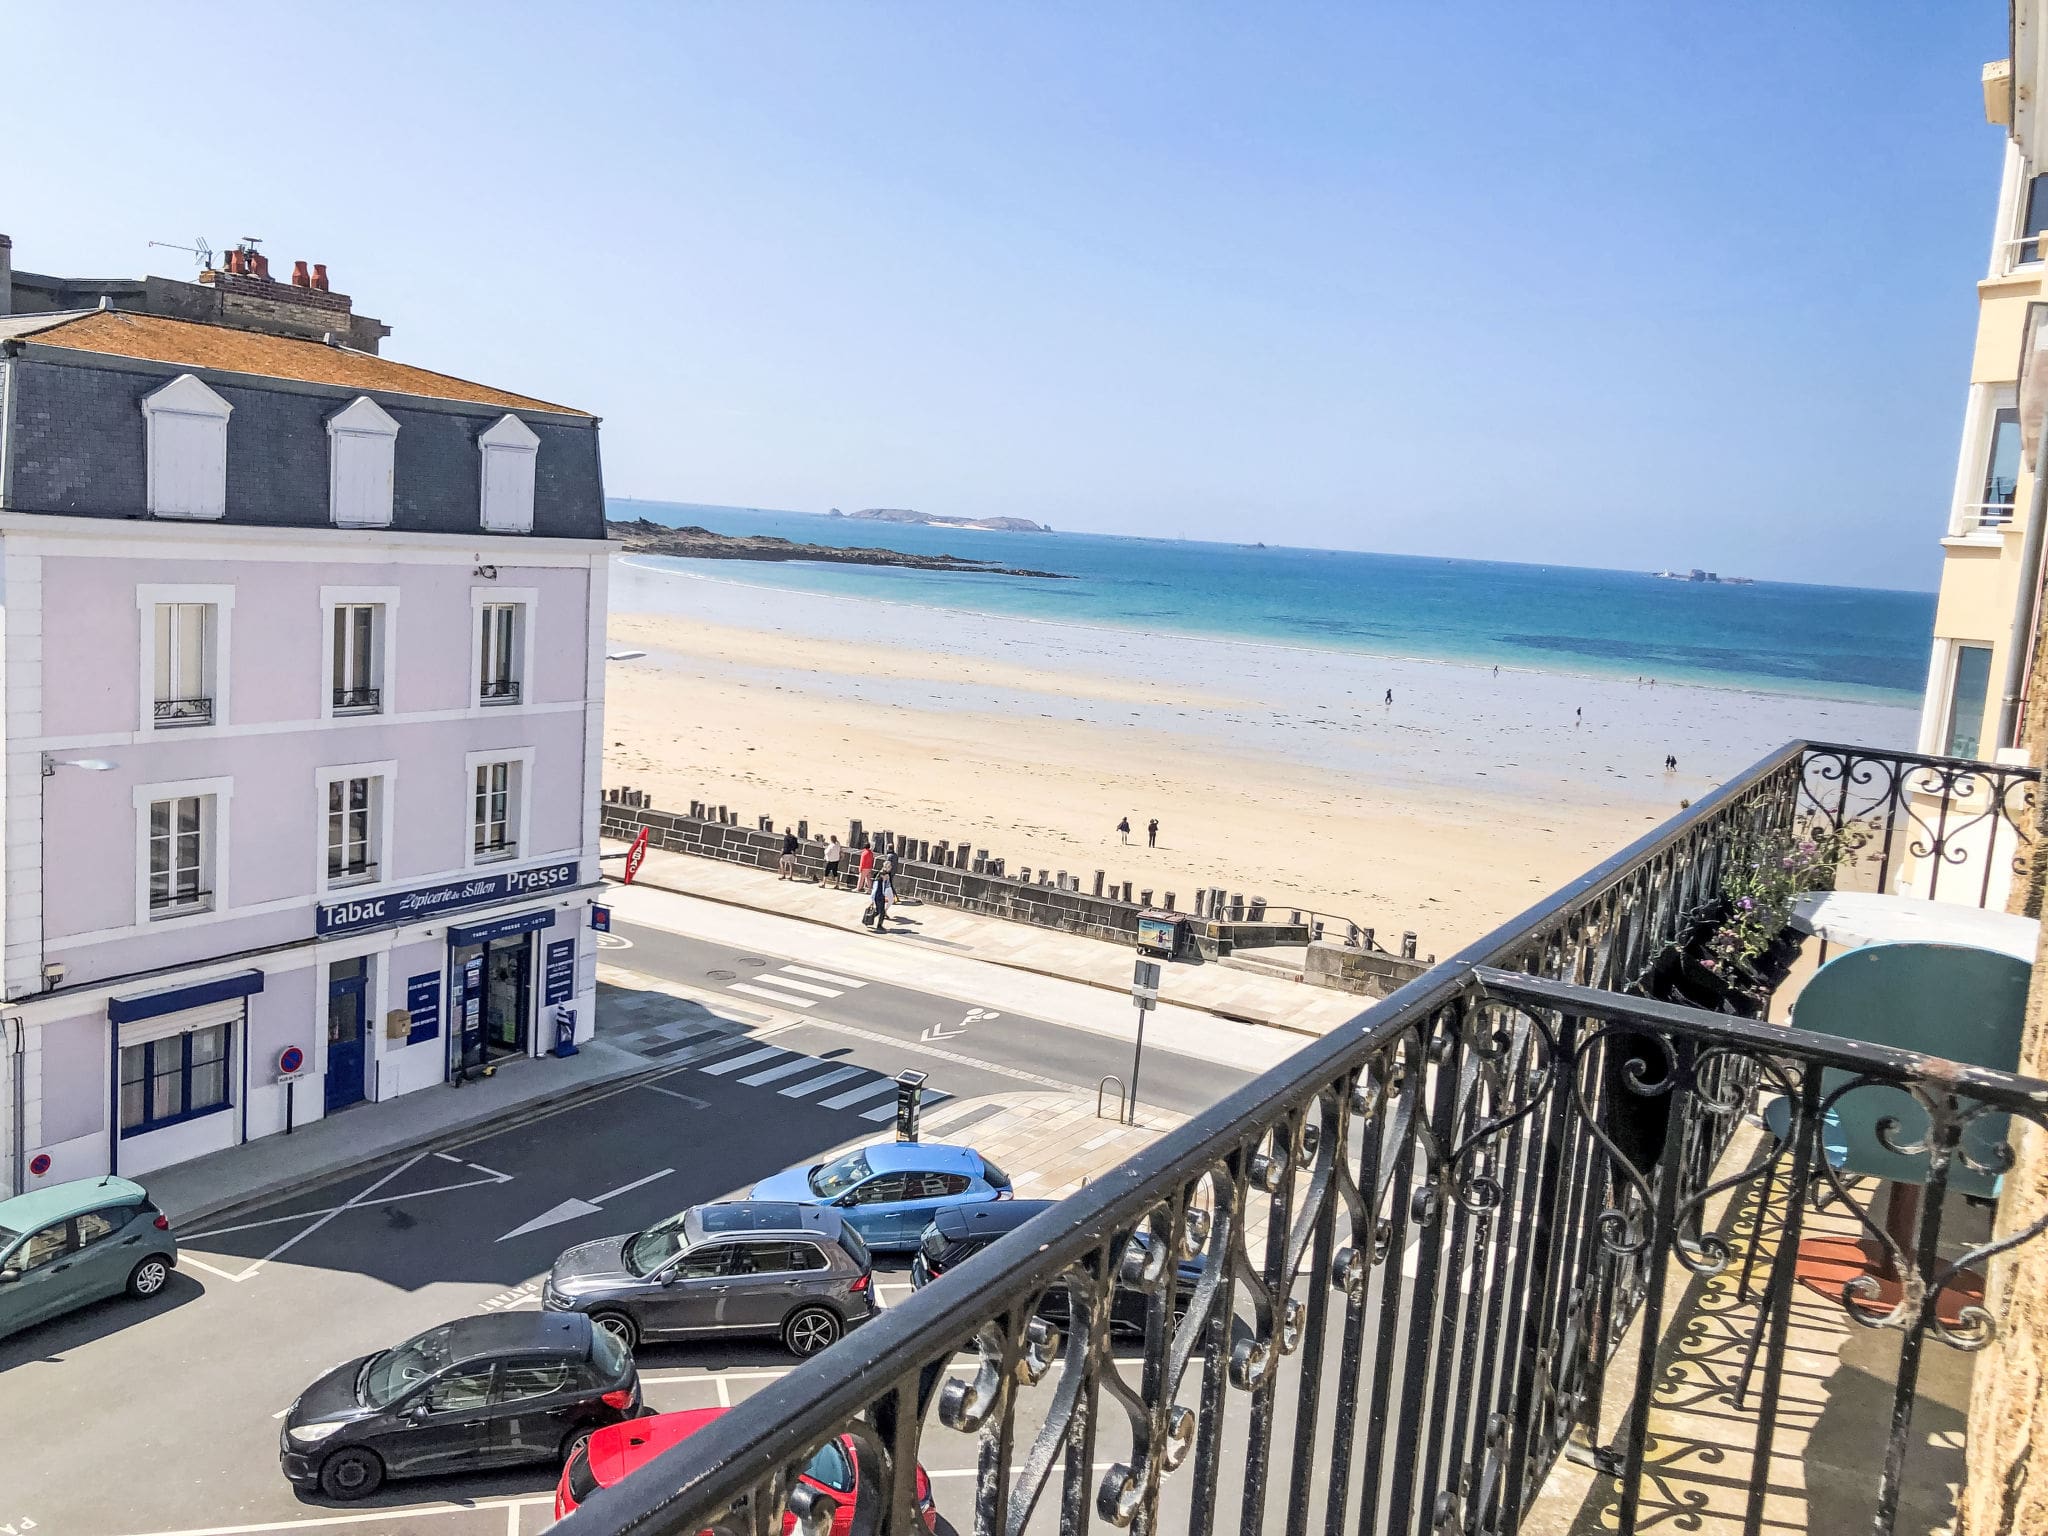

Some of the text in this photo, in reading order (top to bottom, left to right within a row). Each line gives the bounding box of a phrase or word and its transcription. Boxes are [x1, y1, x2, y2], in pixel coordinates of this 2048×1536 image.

[323, 900, 386, 927] Tabac
[461, 881, 496, 899] Sillon
[505, 866, 570, 892] Presse
[472, 930, 488, 938] TABAC
[501, 922, 521, 931] PRESSE
